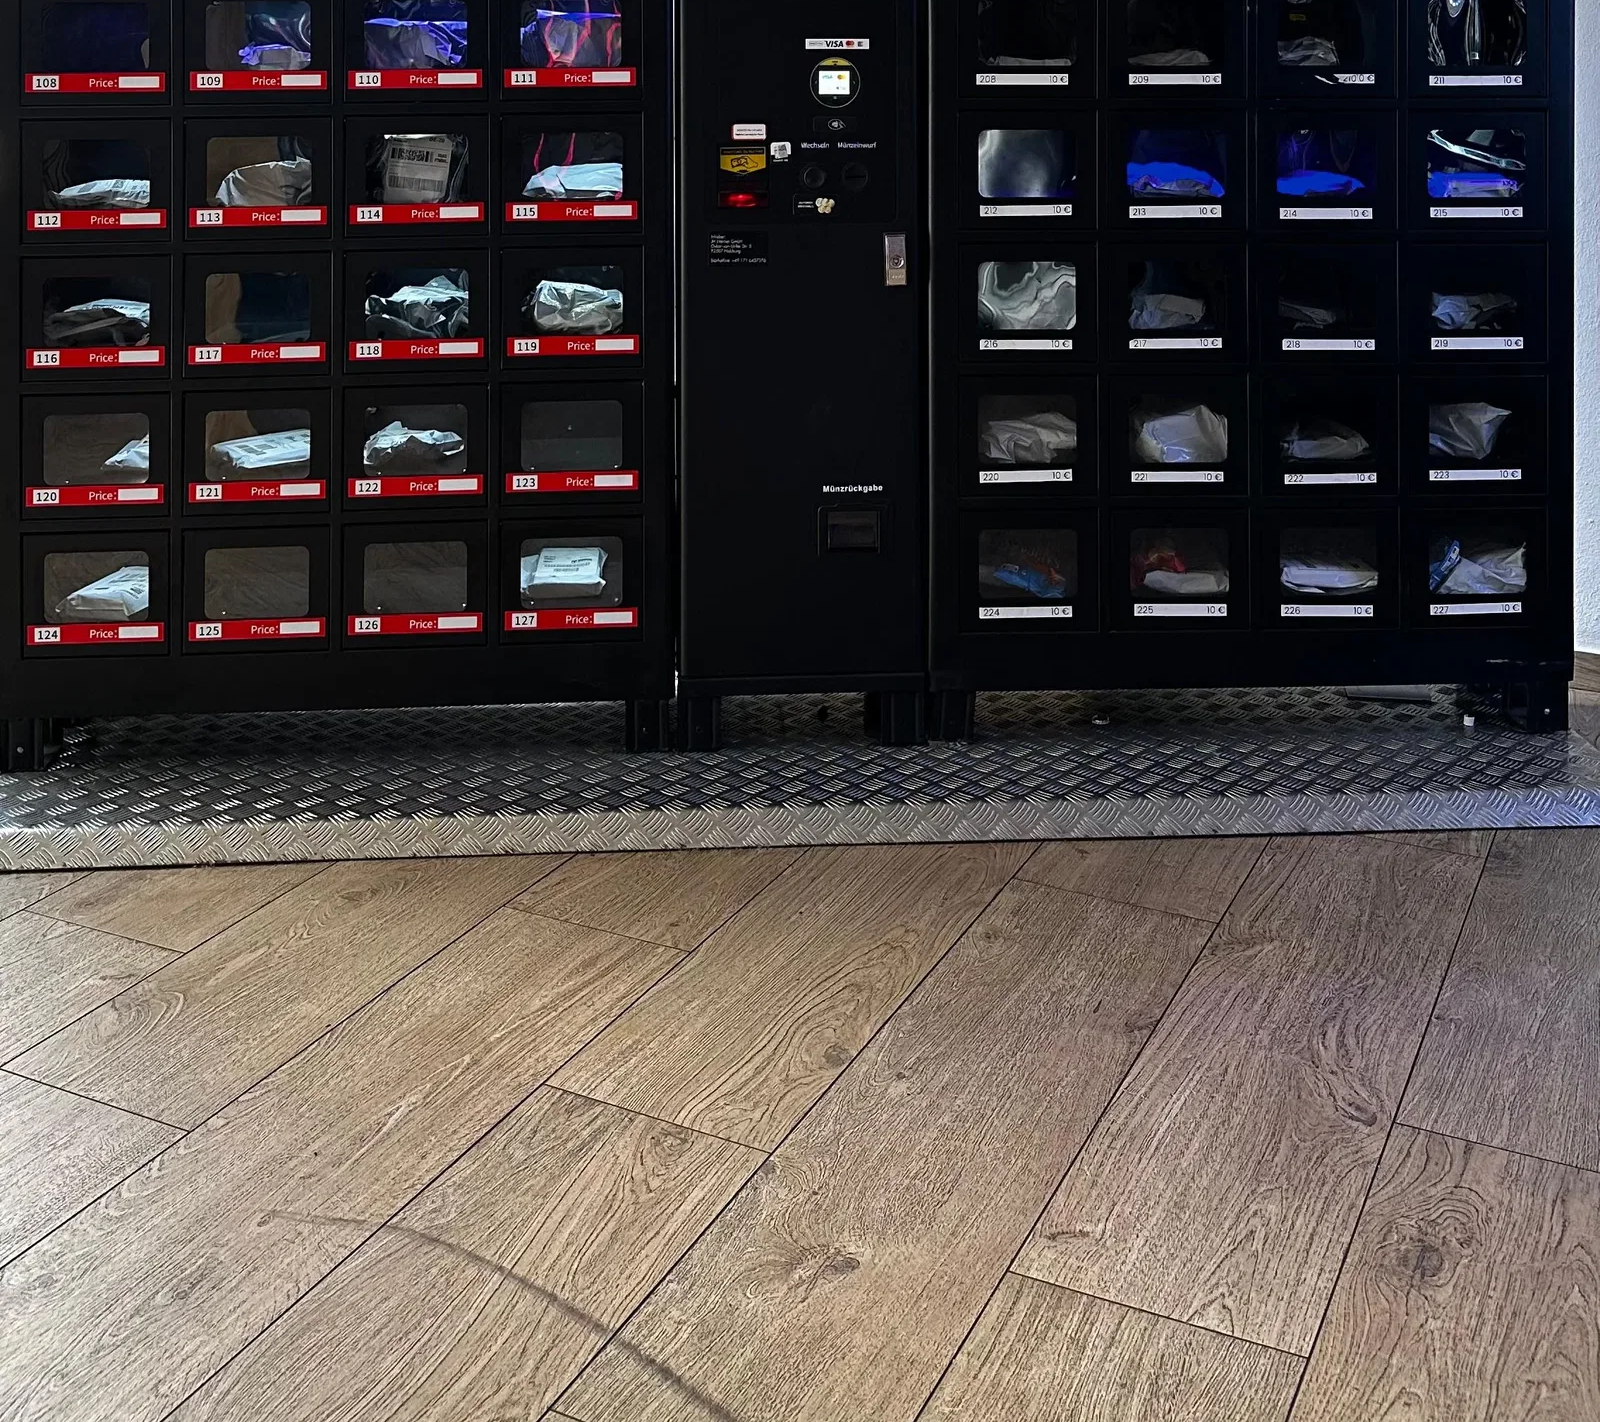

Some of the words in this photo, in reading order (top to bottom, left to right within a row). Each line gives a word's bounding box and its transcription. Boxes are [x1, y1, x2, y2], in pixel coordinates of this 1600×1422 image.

[824, 40, 844, 48] VISA
[35, 77, 57, 88] 108
[89, 78, 118, 88] Price:
[200, 76, 221, 86] 109
[252, 76, 280, 86] Price:
[358, 74, 379, 85] 110
[409, 74, 437, 84] Price:
[514, 73, 534, 83] 111
[564, 73, 591, 83] Price:
[979, 74, 997, 84] 208
[1049, 74, 1058, 84] 10
[1059, 75, 1068, 84] €
[1132, 75, 1149, 84] 209
[1200, 74, 1211, 84] 10
[1212, 75, 1221, 84] €
[1367, 74, 1374, 83] €
[1433, 76, 1445, 85] 211
[1502, 76, 1512, 85] 10
[1512, 76, 1522, 85] €
[360, 209, 381, 220] 114
[411, 209, 439, 219] Price:
[516, 207, 536, 217] 115
[565, 207, 593, 217] Price:
[983, 206, 998, 215] 212
[1052, 205, 1061, 214] 10
[1063, 205, 1072, 214] €
[1132, 207, 1147, 217] 213
[1198, 206, 1208, 216] 10
[1209, 206, 1218, 216] €
[1283, 209, 1298, 218] 214
[1349, 209, 1360, 218] 10
[1361, 209, 1369, 218] €
[1433, 208, 1448, 217] 215
[1500, 208, 1510, 217] 10
[1511, 208, 1520, 217] €
[37, 215, 58, 226] 112
[90, 215, 119, 225] Price:
[200, 212, 220, 223] 113
[252, 211, 280, 222] Price:
[517, 341, 537, 352] 119
[567, 341, 595, 351] Price:
[983, 340, 999, 349] 216
[1051, 340, 1060, 348] 10
[1061, 340, 1070, 348] €
[1133, 339, 1148, 348] 217
[1199, 338, 1209, 347] 10
[1210, 338, 1219, 347] €
[1286, 339, 1301, 349] 218
[1353, 340, 1363, 349] 10
[1364, 340, 1373, 349] €
[1434, 338, 1449, 348] 219
[1503, 338, 1512, 348] 10
[1514, 338, 1522, 348] €
[199, 349, 219, 360] 117
[250, 348, 279, 358] Price:
[359, 345, 380, 356] 118
[410, 344, 438, 354] Price:
[37, 353, 58, 364] 116
[89, 352, 118, 362] Price:
[982, 472, 1000, 482] 220
[1051, 471, 1062, 480] 10
[1062, 471, 1071, 480] €
[1134, 472, 1148, 481] 221
[1203, 472, 1212, 481] 10
[1214, 472, 1223, 481] €
[1287, 474, 1304, 483] 222
[1356, 474, 1366, 482] 10
[1367, 473, 1376, 482] €
[1433, 471, 1450, 480] 223
[1499, 470, 1509, 479] 10
[1510, 470, 1519, 479] €
[358, 482, 379, 493] 122
[409, 481, 437, 491] Price:
[515, 477, 536, 488] 123
[566, 477, 593, 487] Price:
[199, 487, 219, 498] 121
[251, 486, 279, 496] Price:
[822, 484, 883, 493] Münzrückgabe
[36, 491, 57, 502] 120
[88, 490, 117, 501] Price:
[983, 608, 1000, 617] 224
[1050, 607, 1060, 616] 10
[1061, 607, 1070, 616] €
[1136, 605, 1154, 615] 225
[1206, 605, 1215, 615] 10
[1217, 605, 1226, 615] €
[1284, 606, 1301, 615] 226
[1353, 606, 1362, 615] 10
[1364, 606, 1372, 615] €
[1433, 605, 1449, 615] 227
[1501, 603, 1511, 612] 10
[1511, 603, 1520, 612] €
[358, 620, 379, 630] 126
[409, 619, 437, 629] Price:
[515, 615, 535, 626] 127
[565, 614, 593, 624] Price:
[38, 629, 58, 640] 124
[89, 629, 118, 639] Price:
[199, 625, 220, 637] 125
[250, 624, 279, 634] Price:
